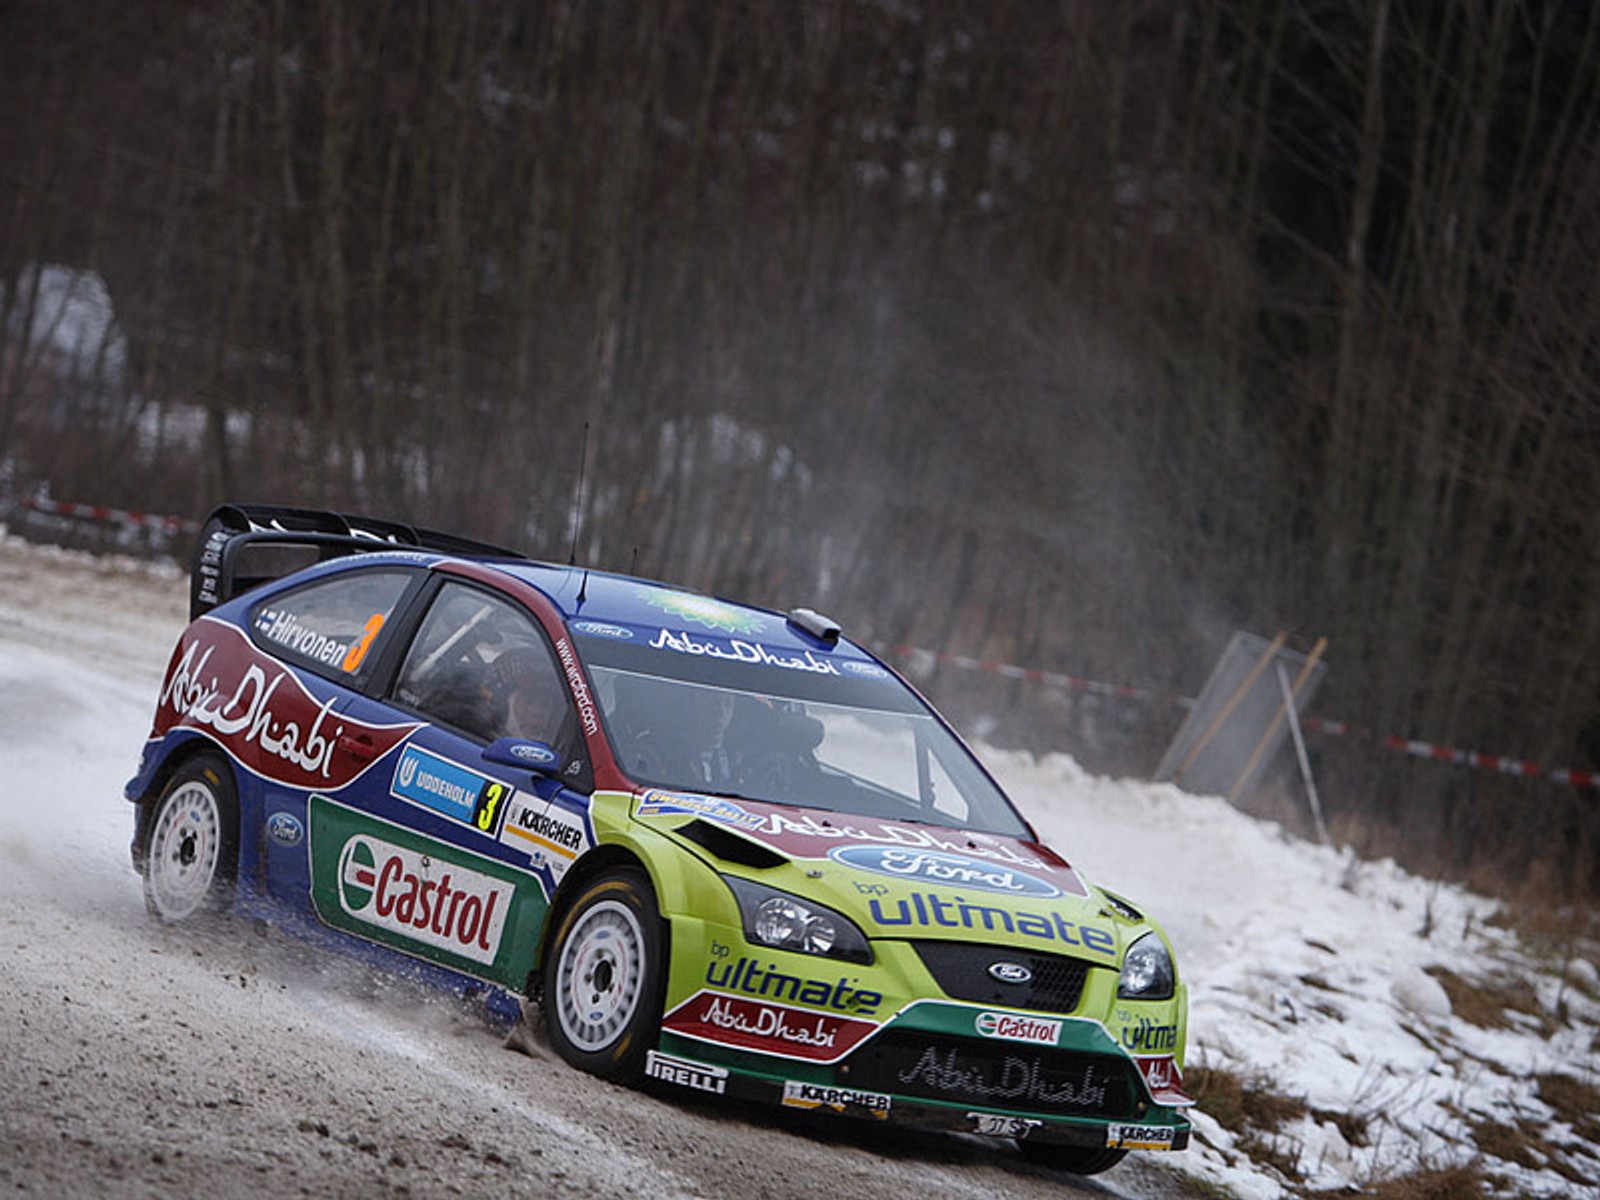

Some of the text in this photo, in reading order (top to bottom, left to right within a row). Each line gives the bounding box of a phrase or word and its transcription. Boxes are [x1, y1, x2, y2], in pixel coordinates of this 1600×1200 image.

[267, 610, 384, 673] Hirvonen 3
[649, 628, 841, 676] Abu Dhabi
[160, 640, 344, 778] Abu Dhabi
[416, 769, 503, 830] UDDEHOLM 3
[273, 816, 298, 840] Ford
[852, 881, 889, 897] bp
[880, 849, 1024, 890] Ford
[375, 855, 500, 952] Castrol
[869, 892, 1117, 955] ultimate
[710, 939, 730, 958] bp
[705, 957, 882, 1015] ultimate
[700, 998, 837, 1047] Abu Dhabi
[996, 1015, 1058, 1043] Castrol
[645, 1049, 729, 1095] PIRELLI
[899, 1046, 1109, 1107] Abu Dhabi
